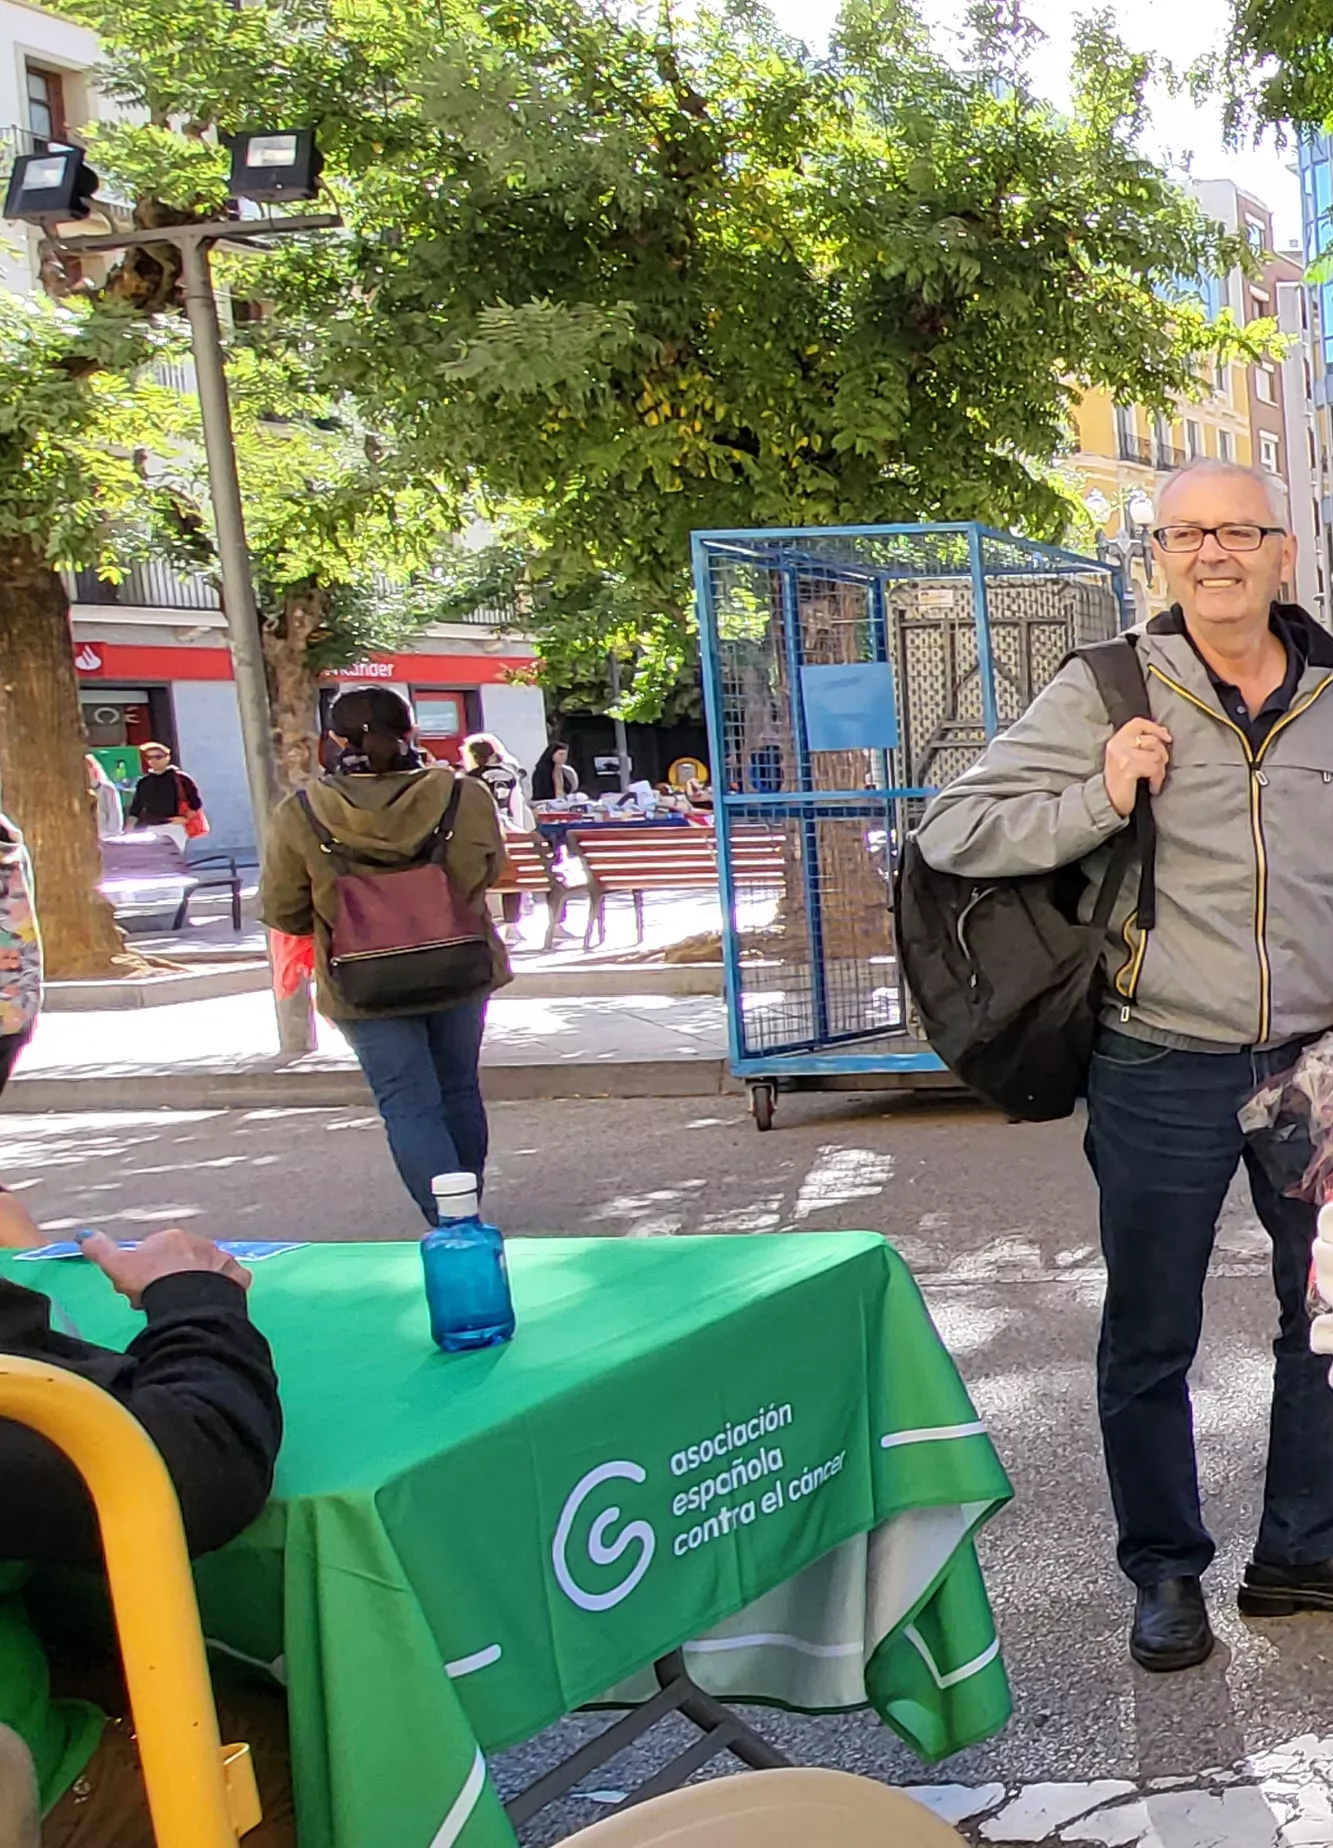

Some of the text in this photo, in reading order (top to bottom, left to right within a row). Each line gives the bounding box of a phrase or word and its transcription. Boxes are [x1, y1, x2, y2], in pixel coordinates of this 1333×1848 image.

[670, 1402, 793, 1477] asociación
[672, 1446, 784, 1517] española
[673, 1449, 847, 1557] contra el cáncer
